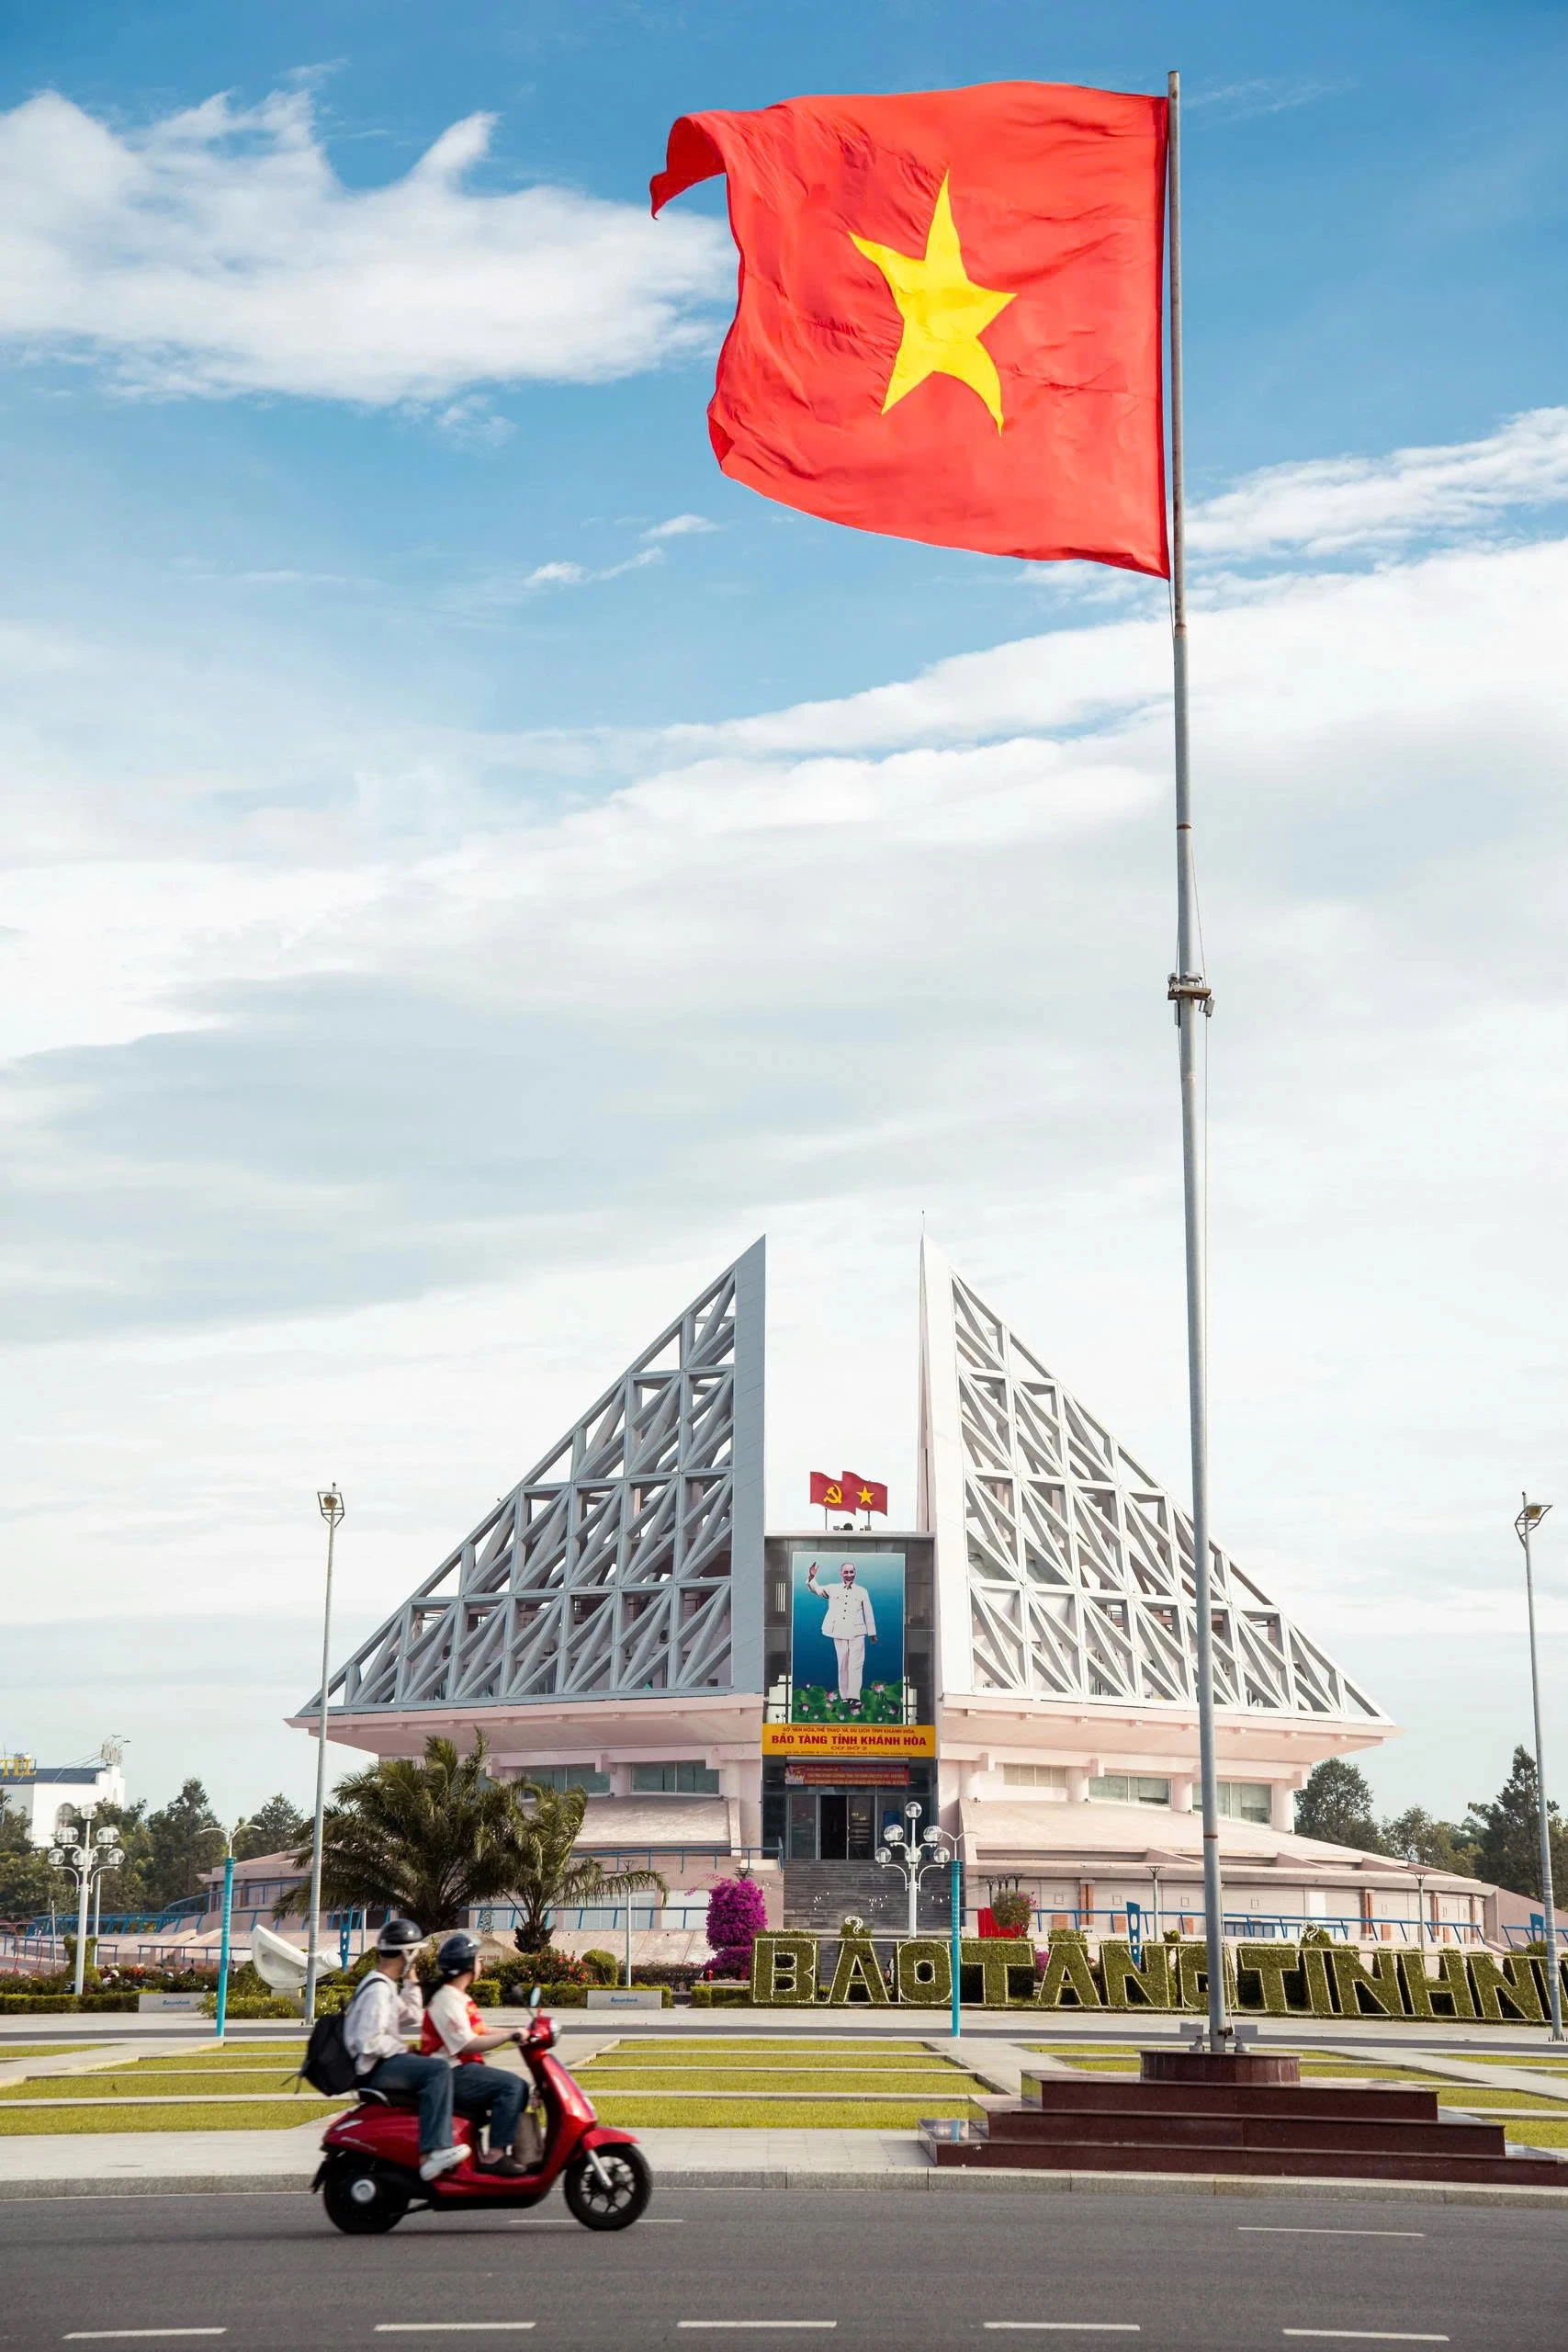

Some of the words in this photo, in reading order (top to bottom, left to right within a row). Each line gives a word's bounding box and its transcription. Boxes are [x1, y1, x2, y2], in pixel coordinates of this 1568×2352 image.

[772, 1733, 794, 1744] BẢO
[798, 1734, 828, 1745] TÀNG
[831, 1734, 857, 1745] TỈNH
[861, 1735, 900, 1746] KHÁNH
[904, 1735, 927, 1746] HÒA
[751, 1916, 953, 2004] BẢO
